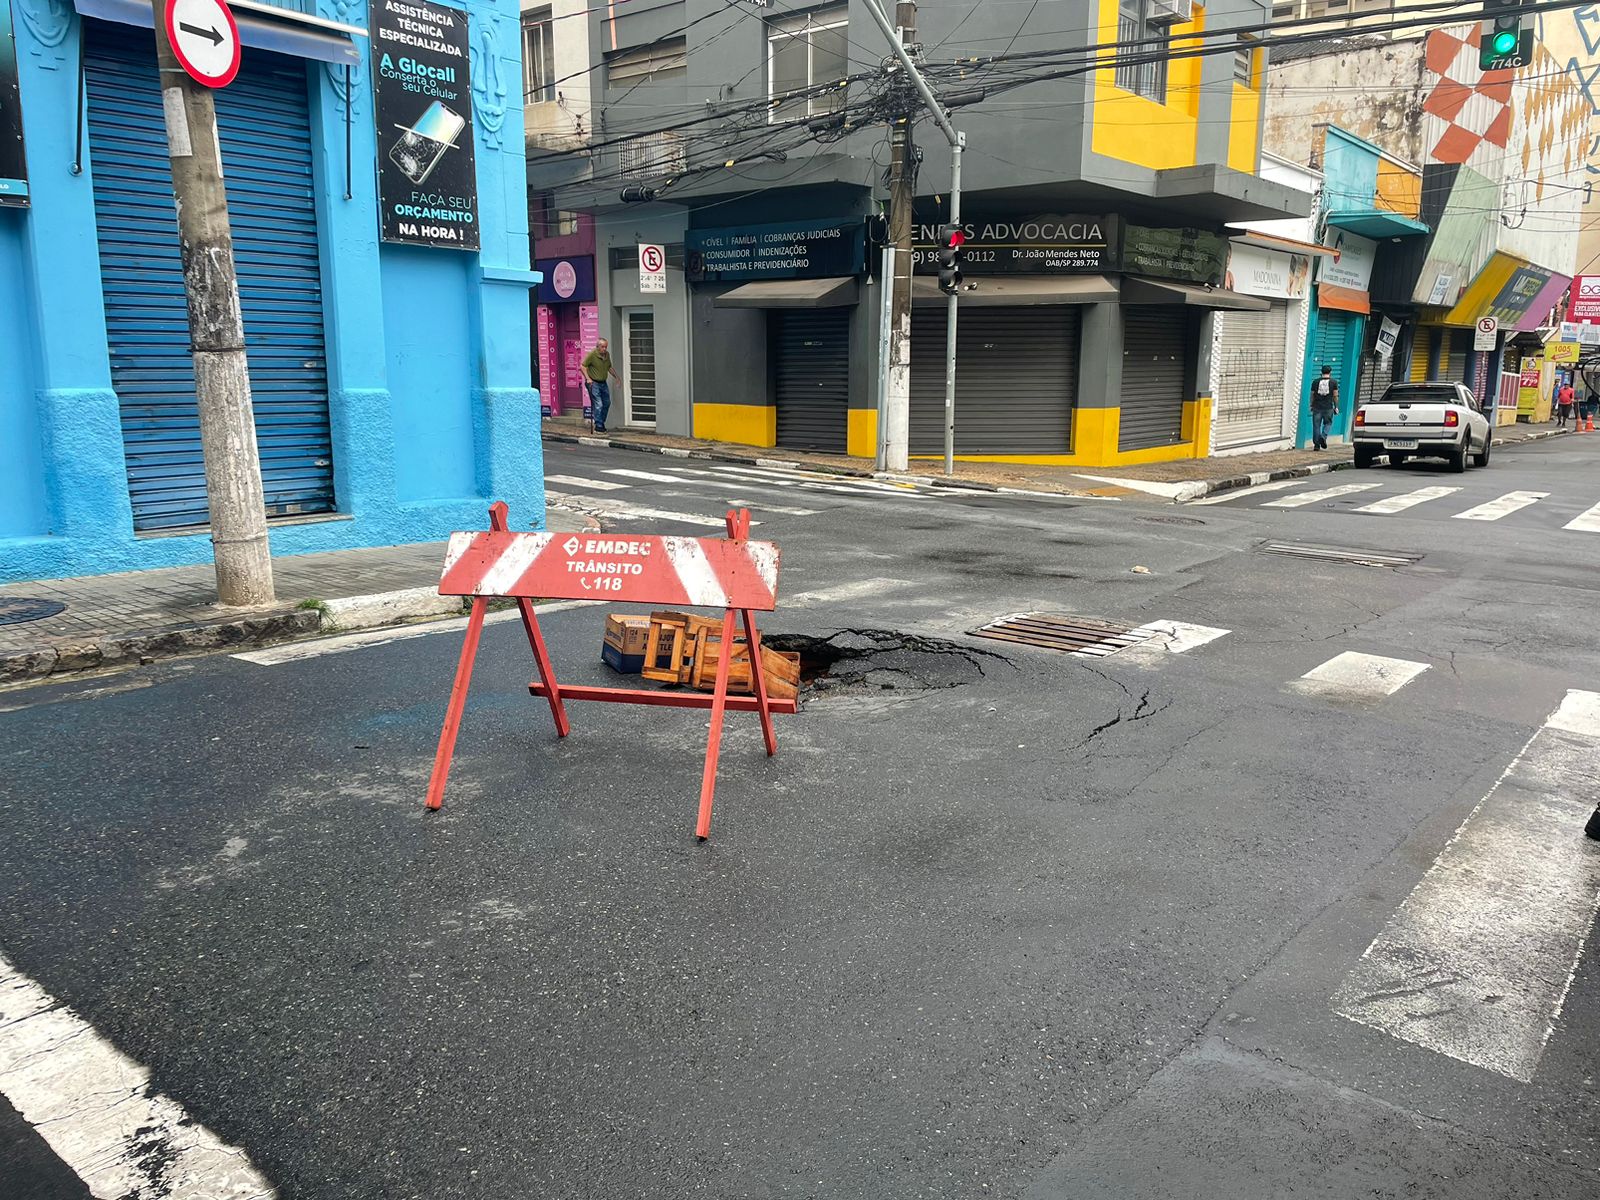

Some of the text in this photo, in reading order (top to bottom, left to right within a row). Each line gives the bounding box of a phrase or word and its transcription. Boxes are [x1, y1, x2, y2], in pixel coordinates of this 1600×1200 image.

[385, 1, 454, 27] ASSISTÊNCIA
[397, 18, 444, 38] TÉCNICA
[380, 28, 462, 57] ESPECIALIZADA
[381, 53, 455, 82] A Glocall
[1491, 56, 1522, 70] 774C
[380, 68, 427, 85] Conserta
[403, 82, 458, 100] seu Celular
[411, 191, 471, 210] FAÇA SEU
[395, 204, 473, 223] ORÇAMENTO
[399, 223, 418, 236] NA
[421, 225, 457, 240] HORA
[706, 229, 840, 247] CÍVEL FAMÍLIA COBRANÇAS JUDICIAIS
[981, 223, 1103, 240] ADVOCACIA
[706, 245, 807, 260] CONSUMIDOR INDENIZAÇÕES
[1012, 250, 1100, 258] Dr. João Mendes Neto
[707, 262, 747, 272] TRABALHISTA
[754, 258, 809, 270] PREVIDENCIÁRIO
[1045, 259, 1071, 267] OAB/SP
[585, 540, 651, 556] EMDEC
[566, 559, 643, 575] TRÂNSITO
[594, 577, 622, 591] 118
